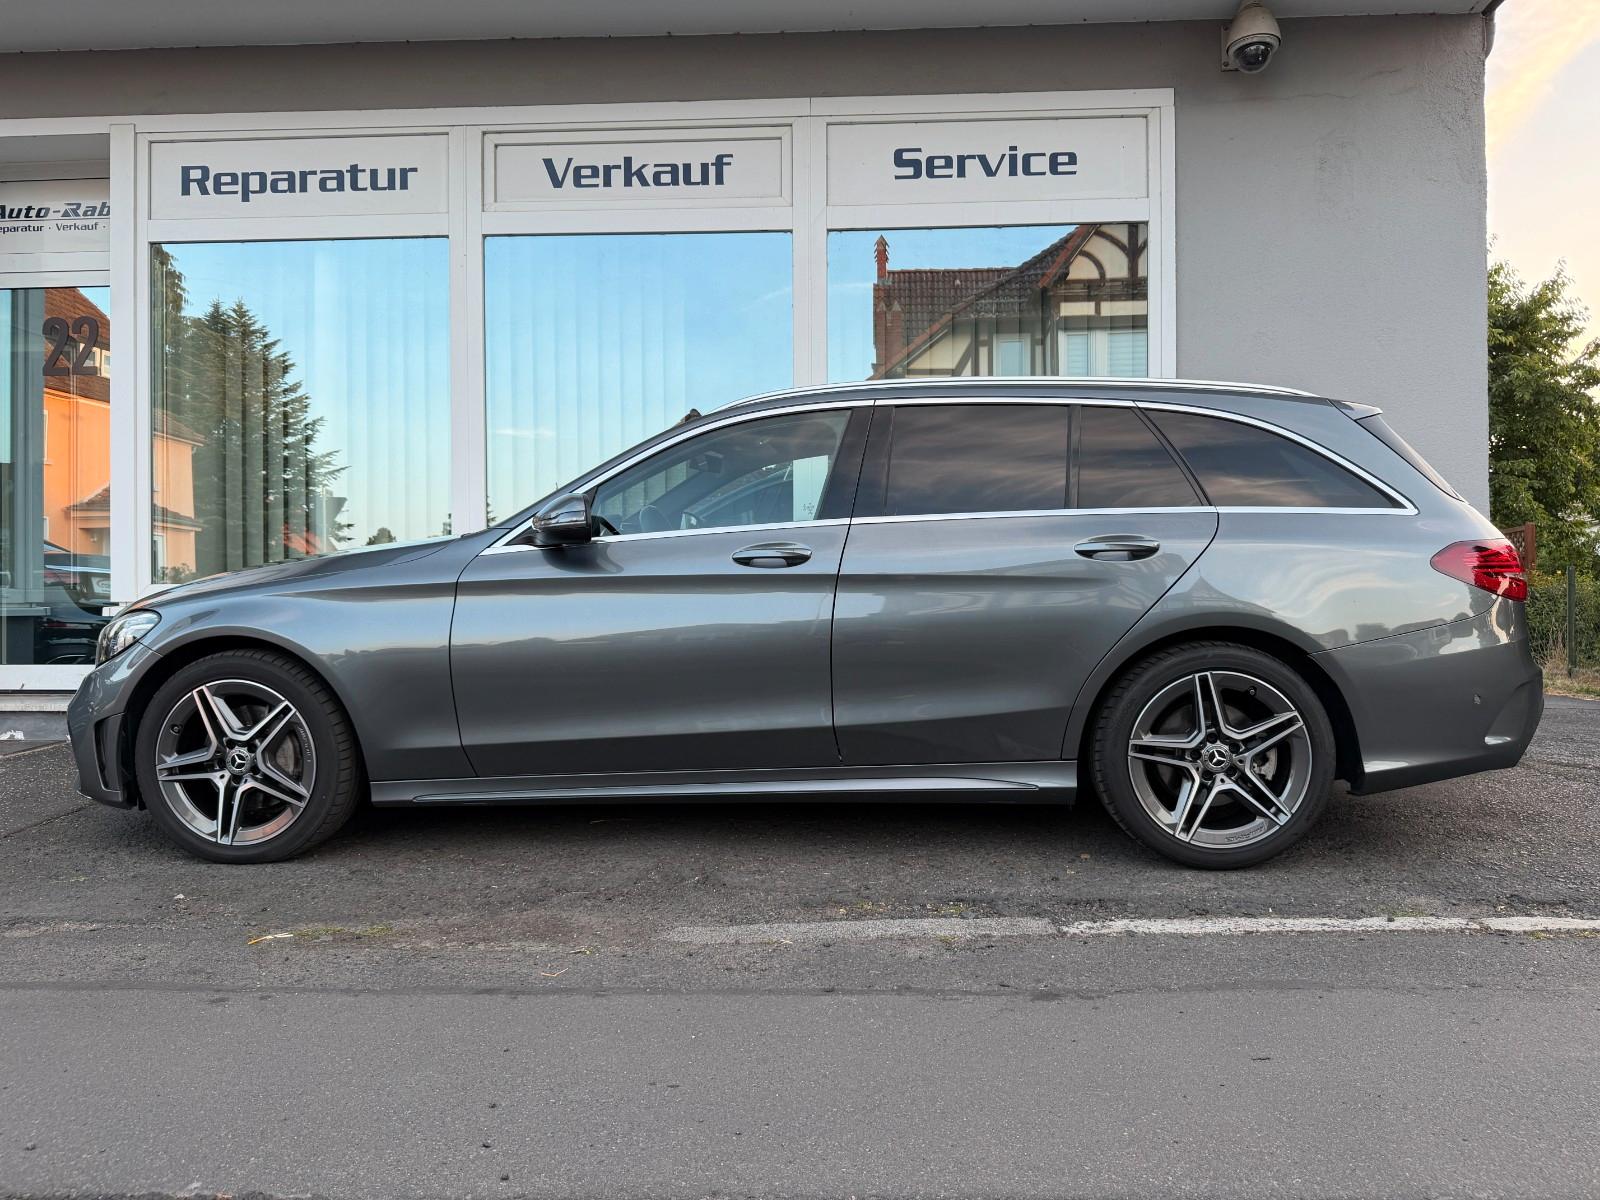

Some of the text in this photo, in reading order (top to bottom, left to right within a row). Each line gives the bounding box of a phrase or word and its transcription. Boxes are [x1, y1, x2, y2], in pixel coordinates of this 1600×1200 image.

[541, 153, 734, 189] Verkauf
[893, 145, 1078, 180] Service
[180, 163, 418, 203] Reparatur
[55, 221, 99, 231] Verkauf
[42, 316, 99, 376] 22
